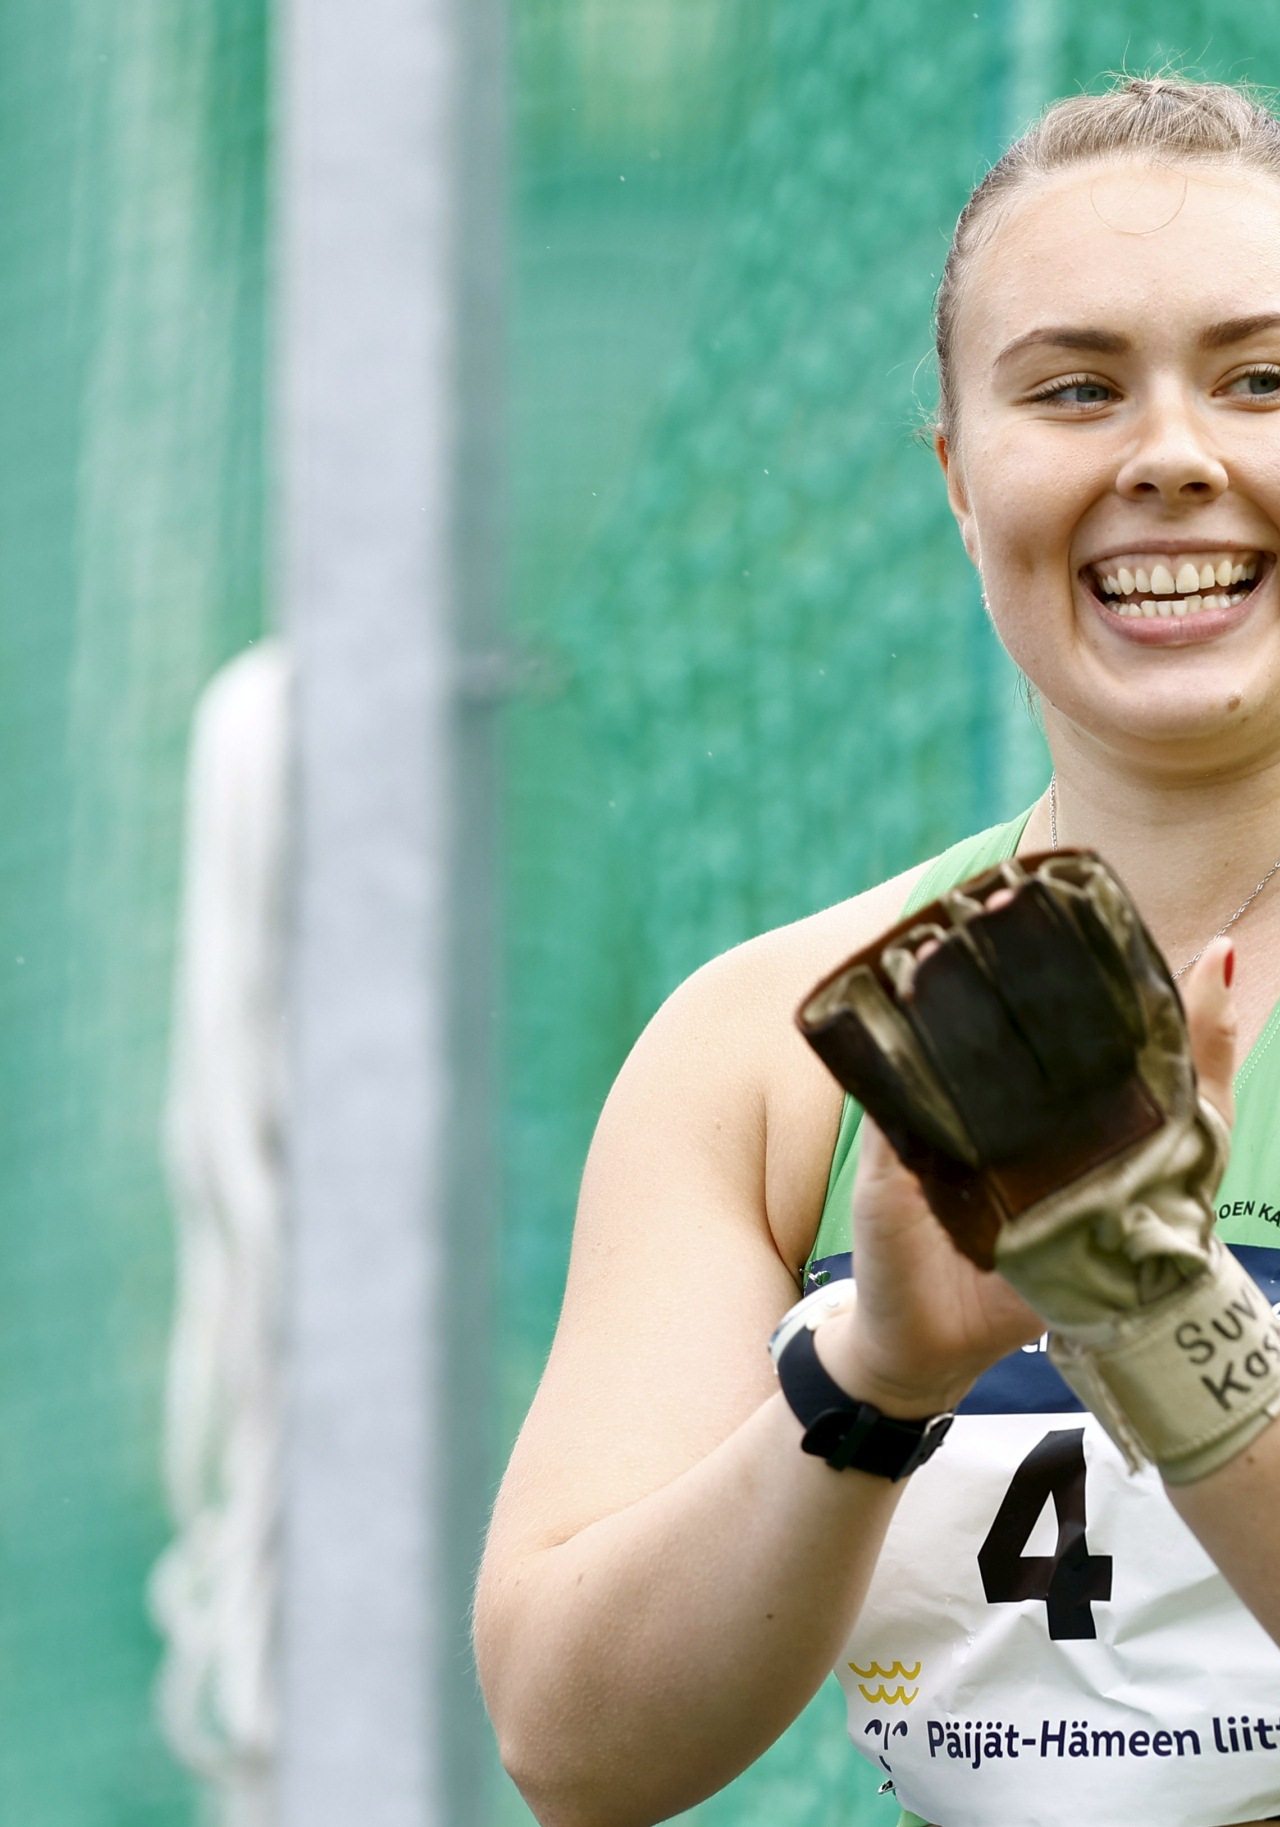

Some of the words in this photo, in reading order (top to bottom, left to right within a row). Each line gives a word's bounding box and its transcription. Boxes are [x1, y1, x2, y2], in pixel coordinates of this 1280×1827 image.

[1213, 1201, 1256, 1220] OEN
[977, 1427, 1113, 1641] 4
[926, 1720, 1202, 1770] Päijät-Hämeen
